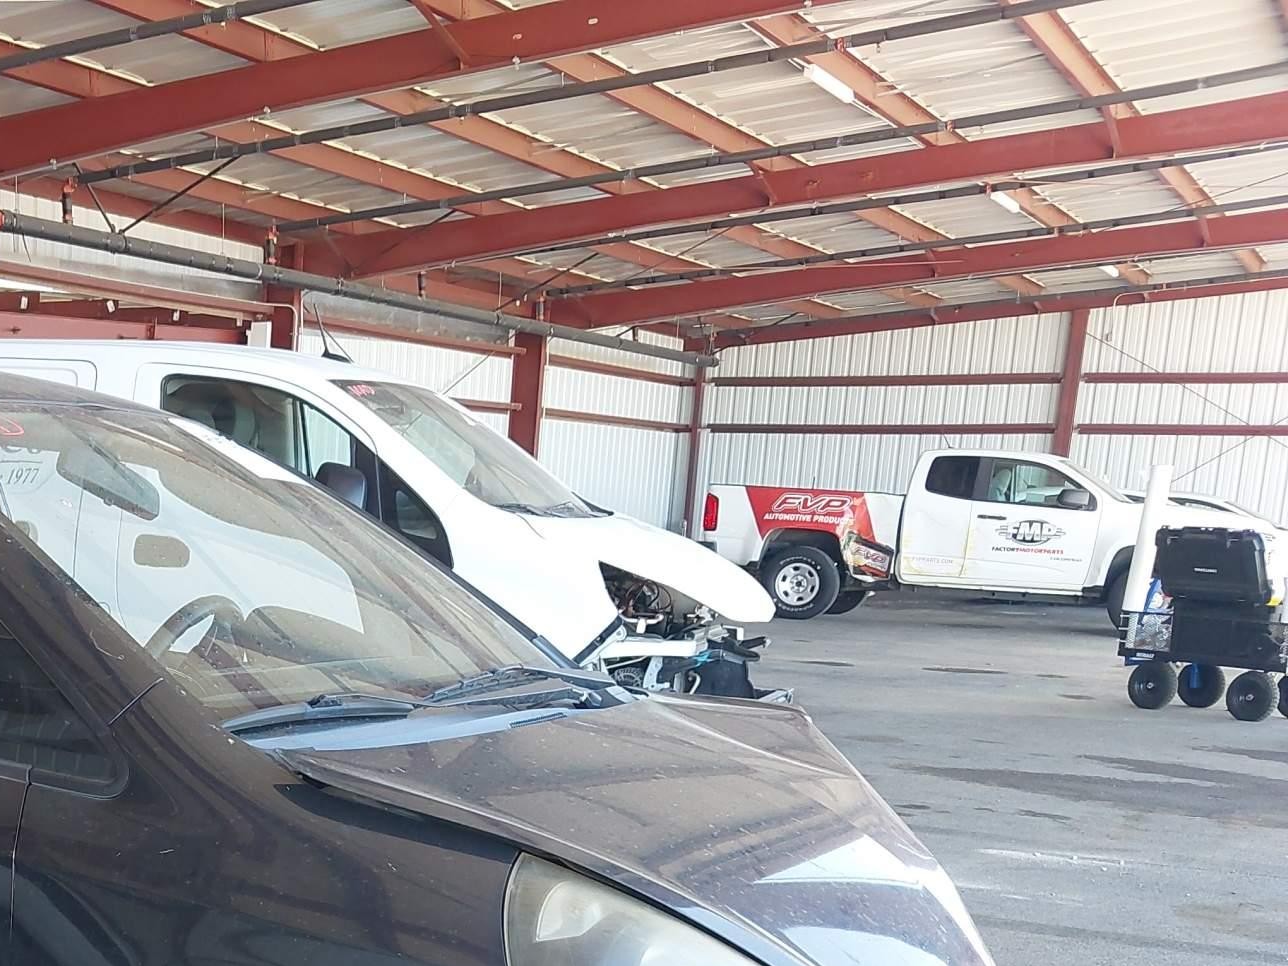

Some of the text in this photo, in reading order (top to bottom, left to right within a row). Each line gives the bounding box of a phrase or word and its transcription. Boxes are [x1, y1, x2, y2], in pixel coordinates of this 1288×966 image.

[7, 467, 40, 485] 1977
[772, 492, 852, 514] FVP
[763, 512, 812, 522] AUTOMOTIVE
[1005, 521, 1058, 541] FMP
[854, 546, 887, 563] FVP
